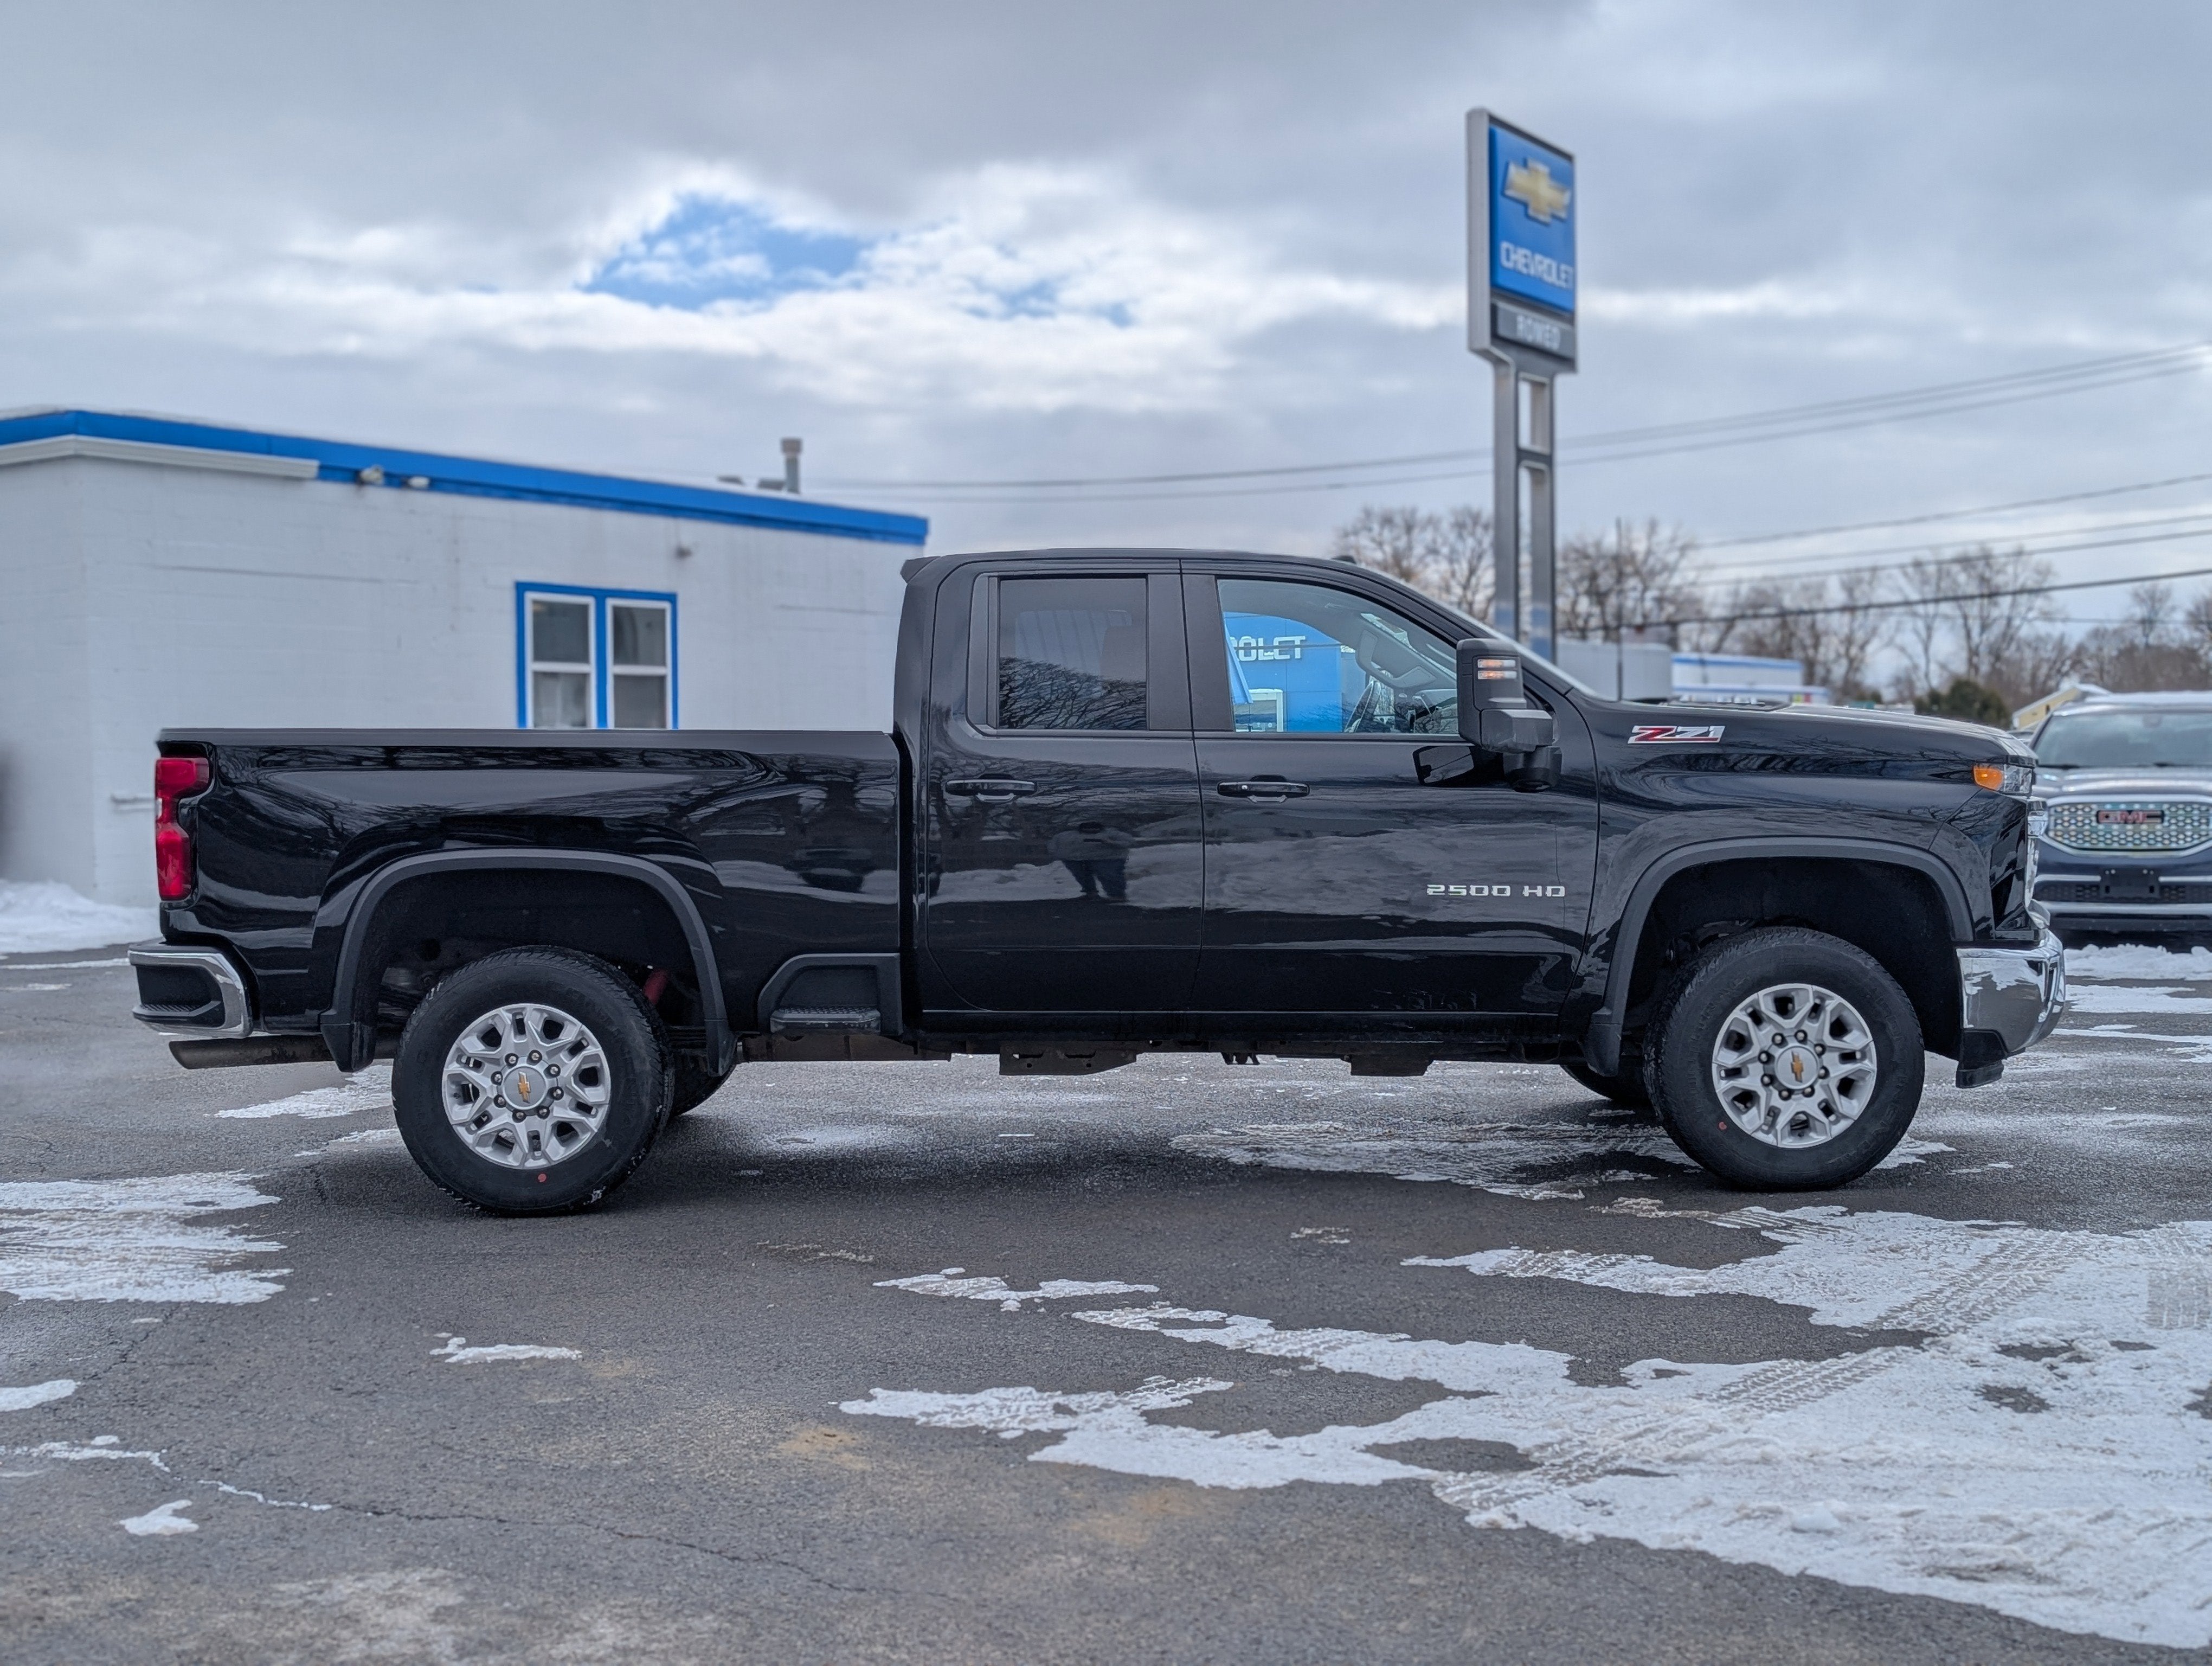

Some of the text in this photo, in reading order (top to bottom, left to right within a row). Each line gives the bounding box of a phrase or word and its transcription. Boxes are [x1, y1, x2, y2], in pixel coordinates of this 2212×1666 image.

[1500, 240, 1574, 289] CHEVROLET
[1628, 725, 1726, 744] Z71
[2098, 810, 2163, 824] GMC
[1426, 884, 1566, 898] 2500 HD
